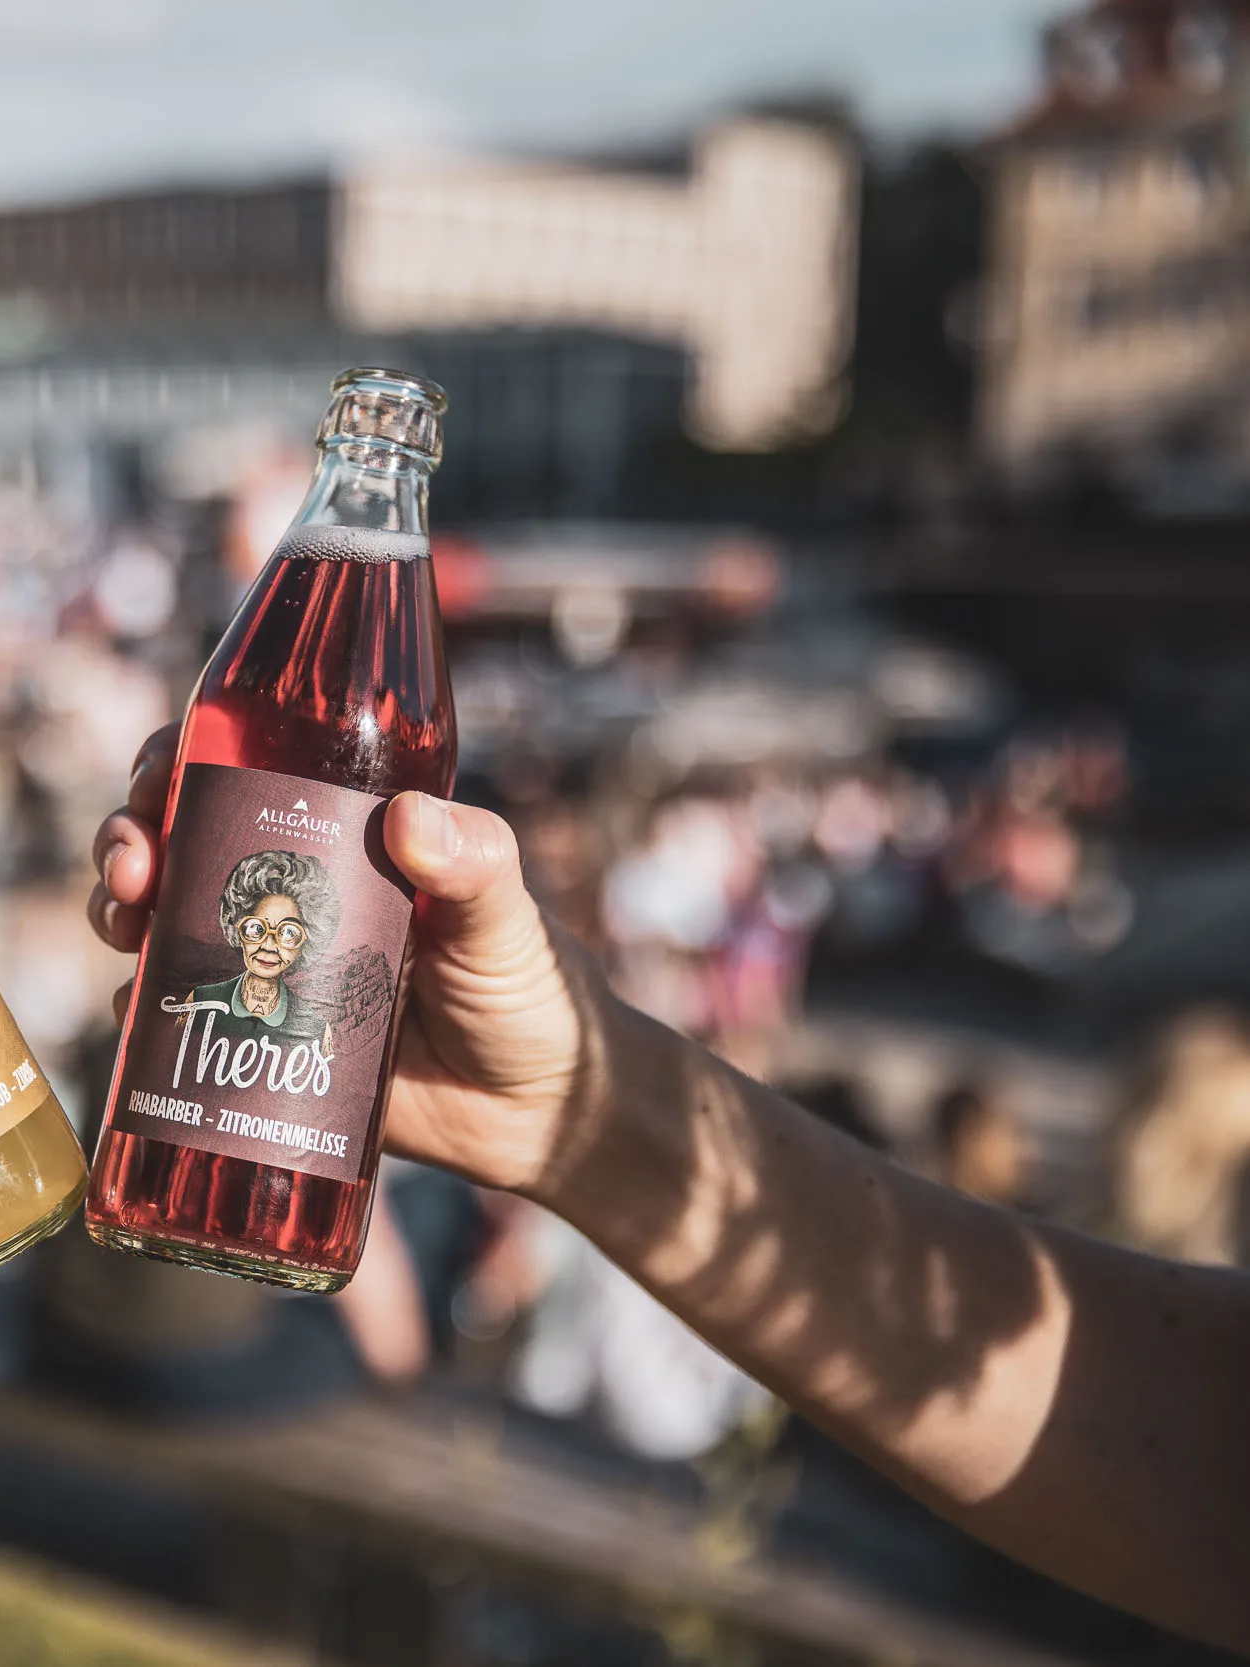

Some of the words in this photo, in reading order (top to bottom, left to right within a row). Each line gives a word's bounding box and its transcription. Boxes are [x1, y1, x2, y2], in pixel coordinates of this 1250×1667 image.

[255, 807, 341, 838] ALLGÄUER
[258, 824, 335, 846] ALPENWASSER
[161, 996, 335, 1097] Theres
[128, 1089, 204, 1127] RHABARBER
[216, 1108, 349, 1158] ZITRONENMELISSE
